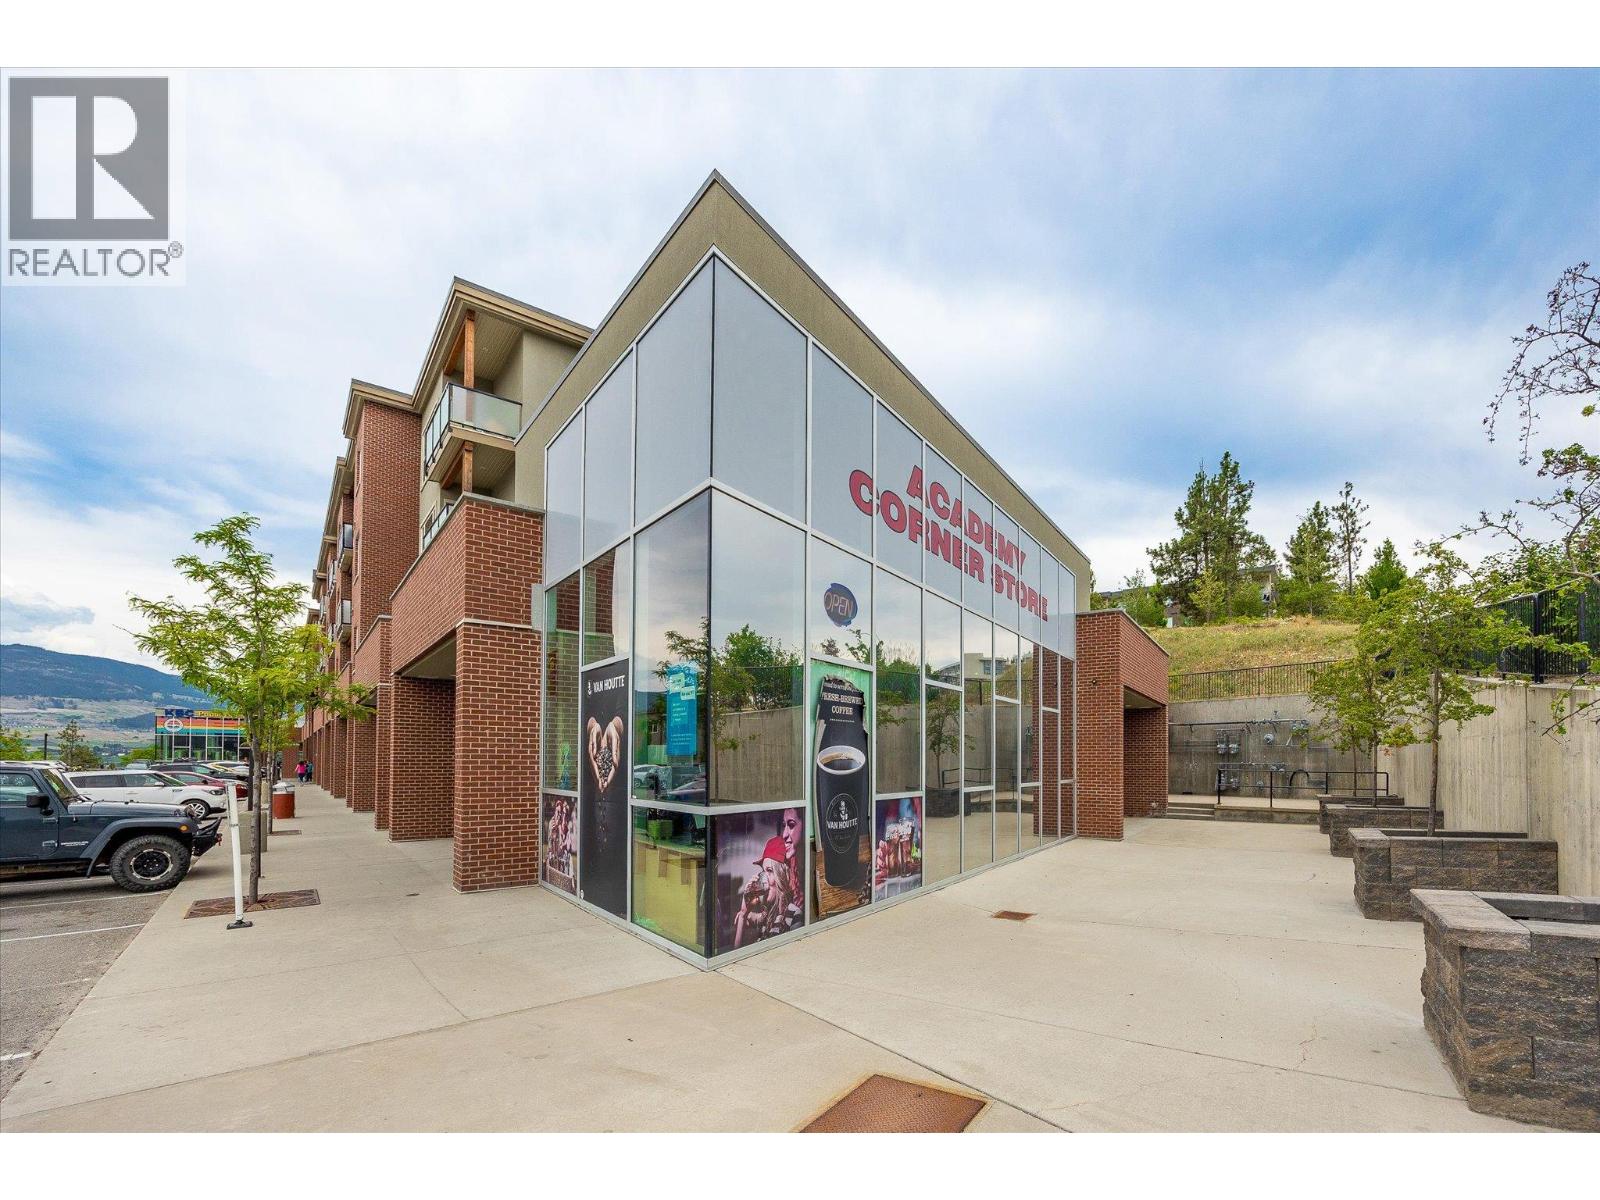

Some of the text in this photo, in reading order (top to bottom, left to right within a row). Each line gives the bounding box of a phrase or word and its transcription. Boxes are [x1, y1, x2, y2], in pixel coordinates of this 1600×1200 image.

[906, 464, 1027, 576] ACADEMY
[849, 469, 1049, 622] CORNER STORE
[824, 591, 854, 618] OPEN
[593, 675, 625, 693] VAN HOUTTE
[831, 705, 854, 716] COFFEE
[826, 817, 858, 830] VAN HOUTTE
